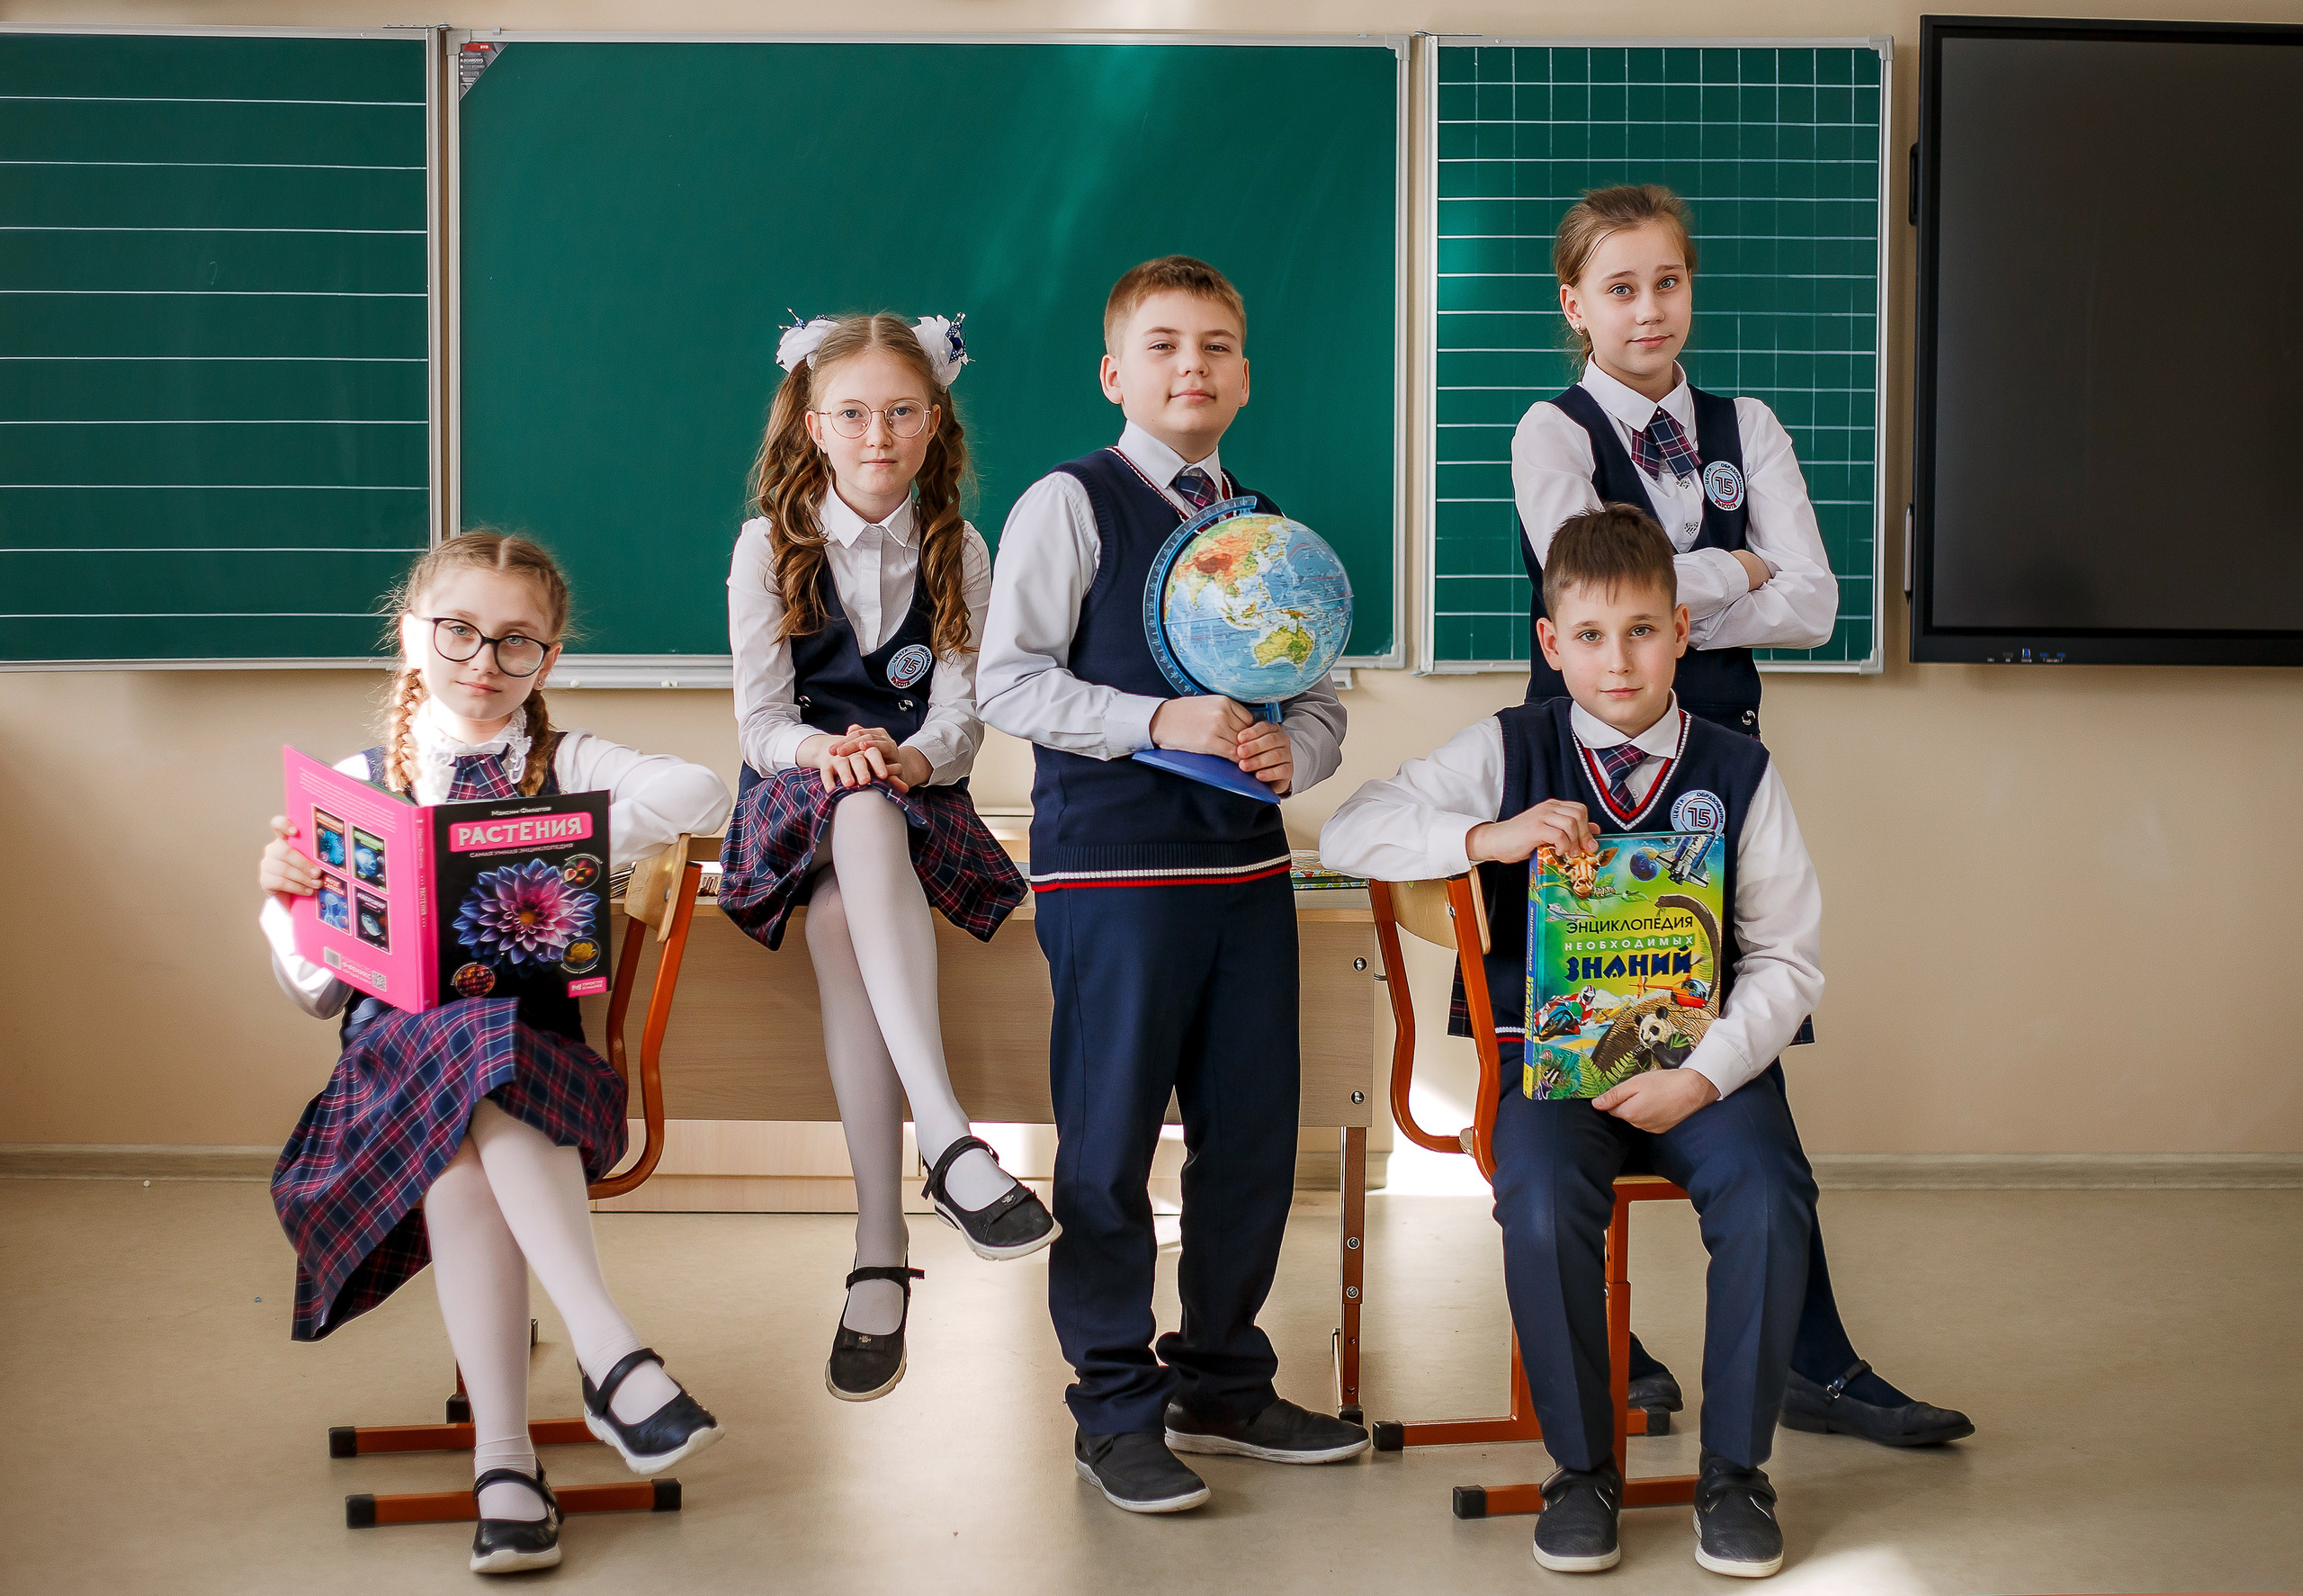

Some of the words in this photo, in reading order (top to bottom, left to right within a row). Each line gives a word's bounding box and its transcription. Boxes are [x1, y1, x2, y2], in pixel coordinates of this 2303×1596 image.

[1715, 476, 1734, 496] 15
[900, 657, 921, 675] 15
[1687, 807, 1712, 828] 15
[458, 816, 583, 847] РАСТЕНИЯ
[1566, 916, 1693, 935] ЭНЦИКЛОПЕДИЯ
[1564, 935, 1694, 952] НЕОБХОДИМЫХ
[1564, 945, 1693, 982] ЗНАНИЙ
